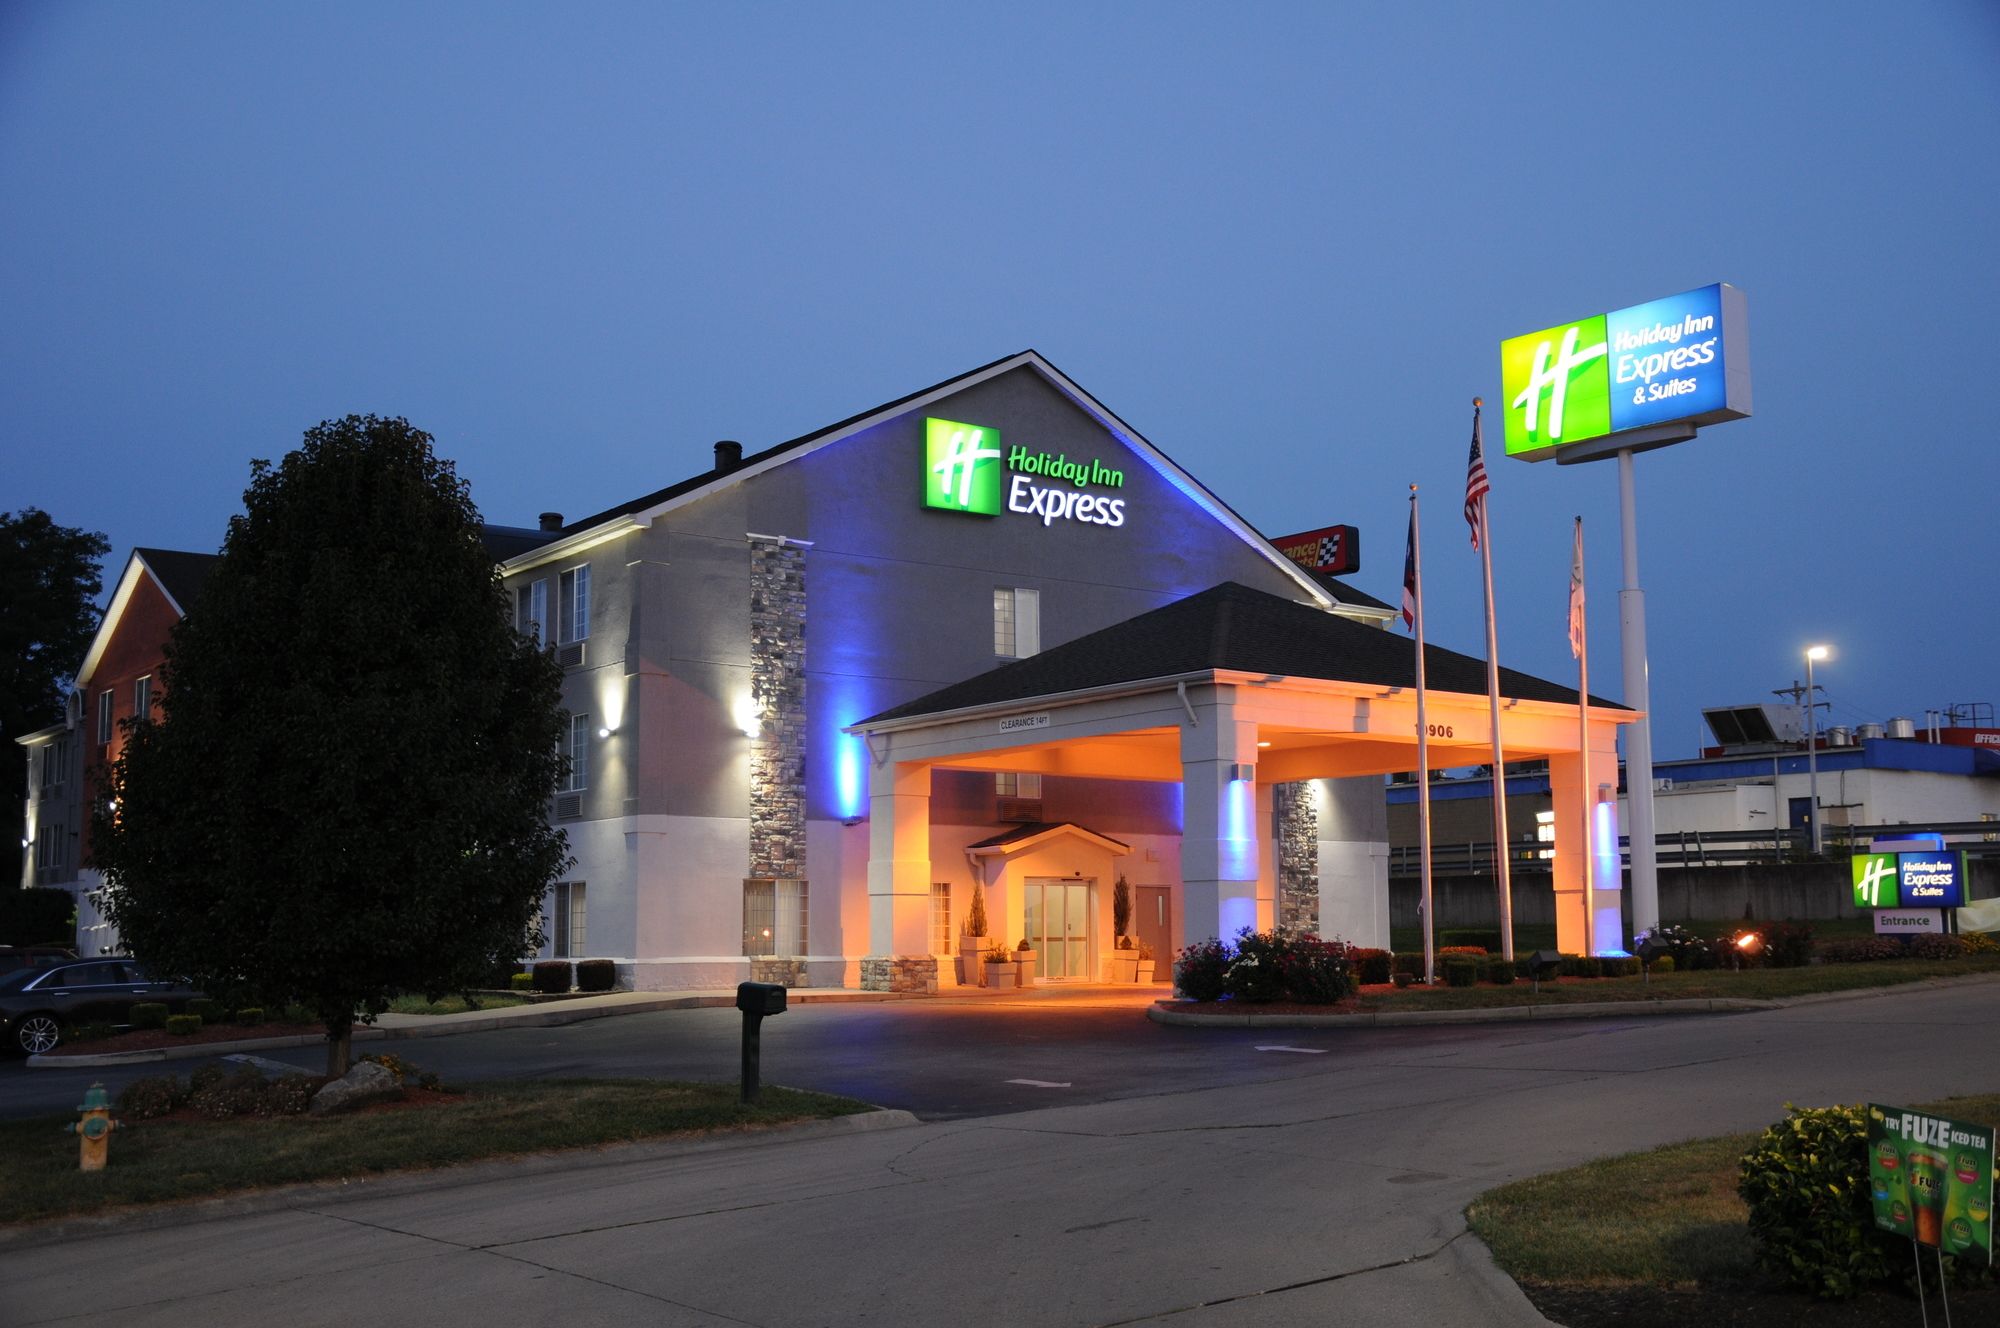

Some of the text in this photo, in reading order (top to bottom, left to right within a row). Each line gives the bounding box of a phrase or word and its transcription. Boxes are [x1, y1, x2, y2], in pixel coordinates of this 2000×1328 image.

[1614, 314, 1714, 353] Holiday Inn
[1615, 341, 1715, 384] Express
[1632, 377, 1697, 405] & Suites
[1008, 445, 1124, 488] Holiday Inn
[1008, 475, 1126, 527] Express
[1001, 717, 1035, 730] CLEARANCE
[1903, 861, 1952, 873] Holiday Inn
[1903, 872, 1953, 887] Express
[1912, 887, 1944, 897] & Suites
[1881, 916, 1930, 926] Entrance
[1885, 1113, 1986, 1149] TRY FUZE ICED TEA
